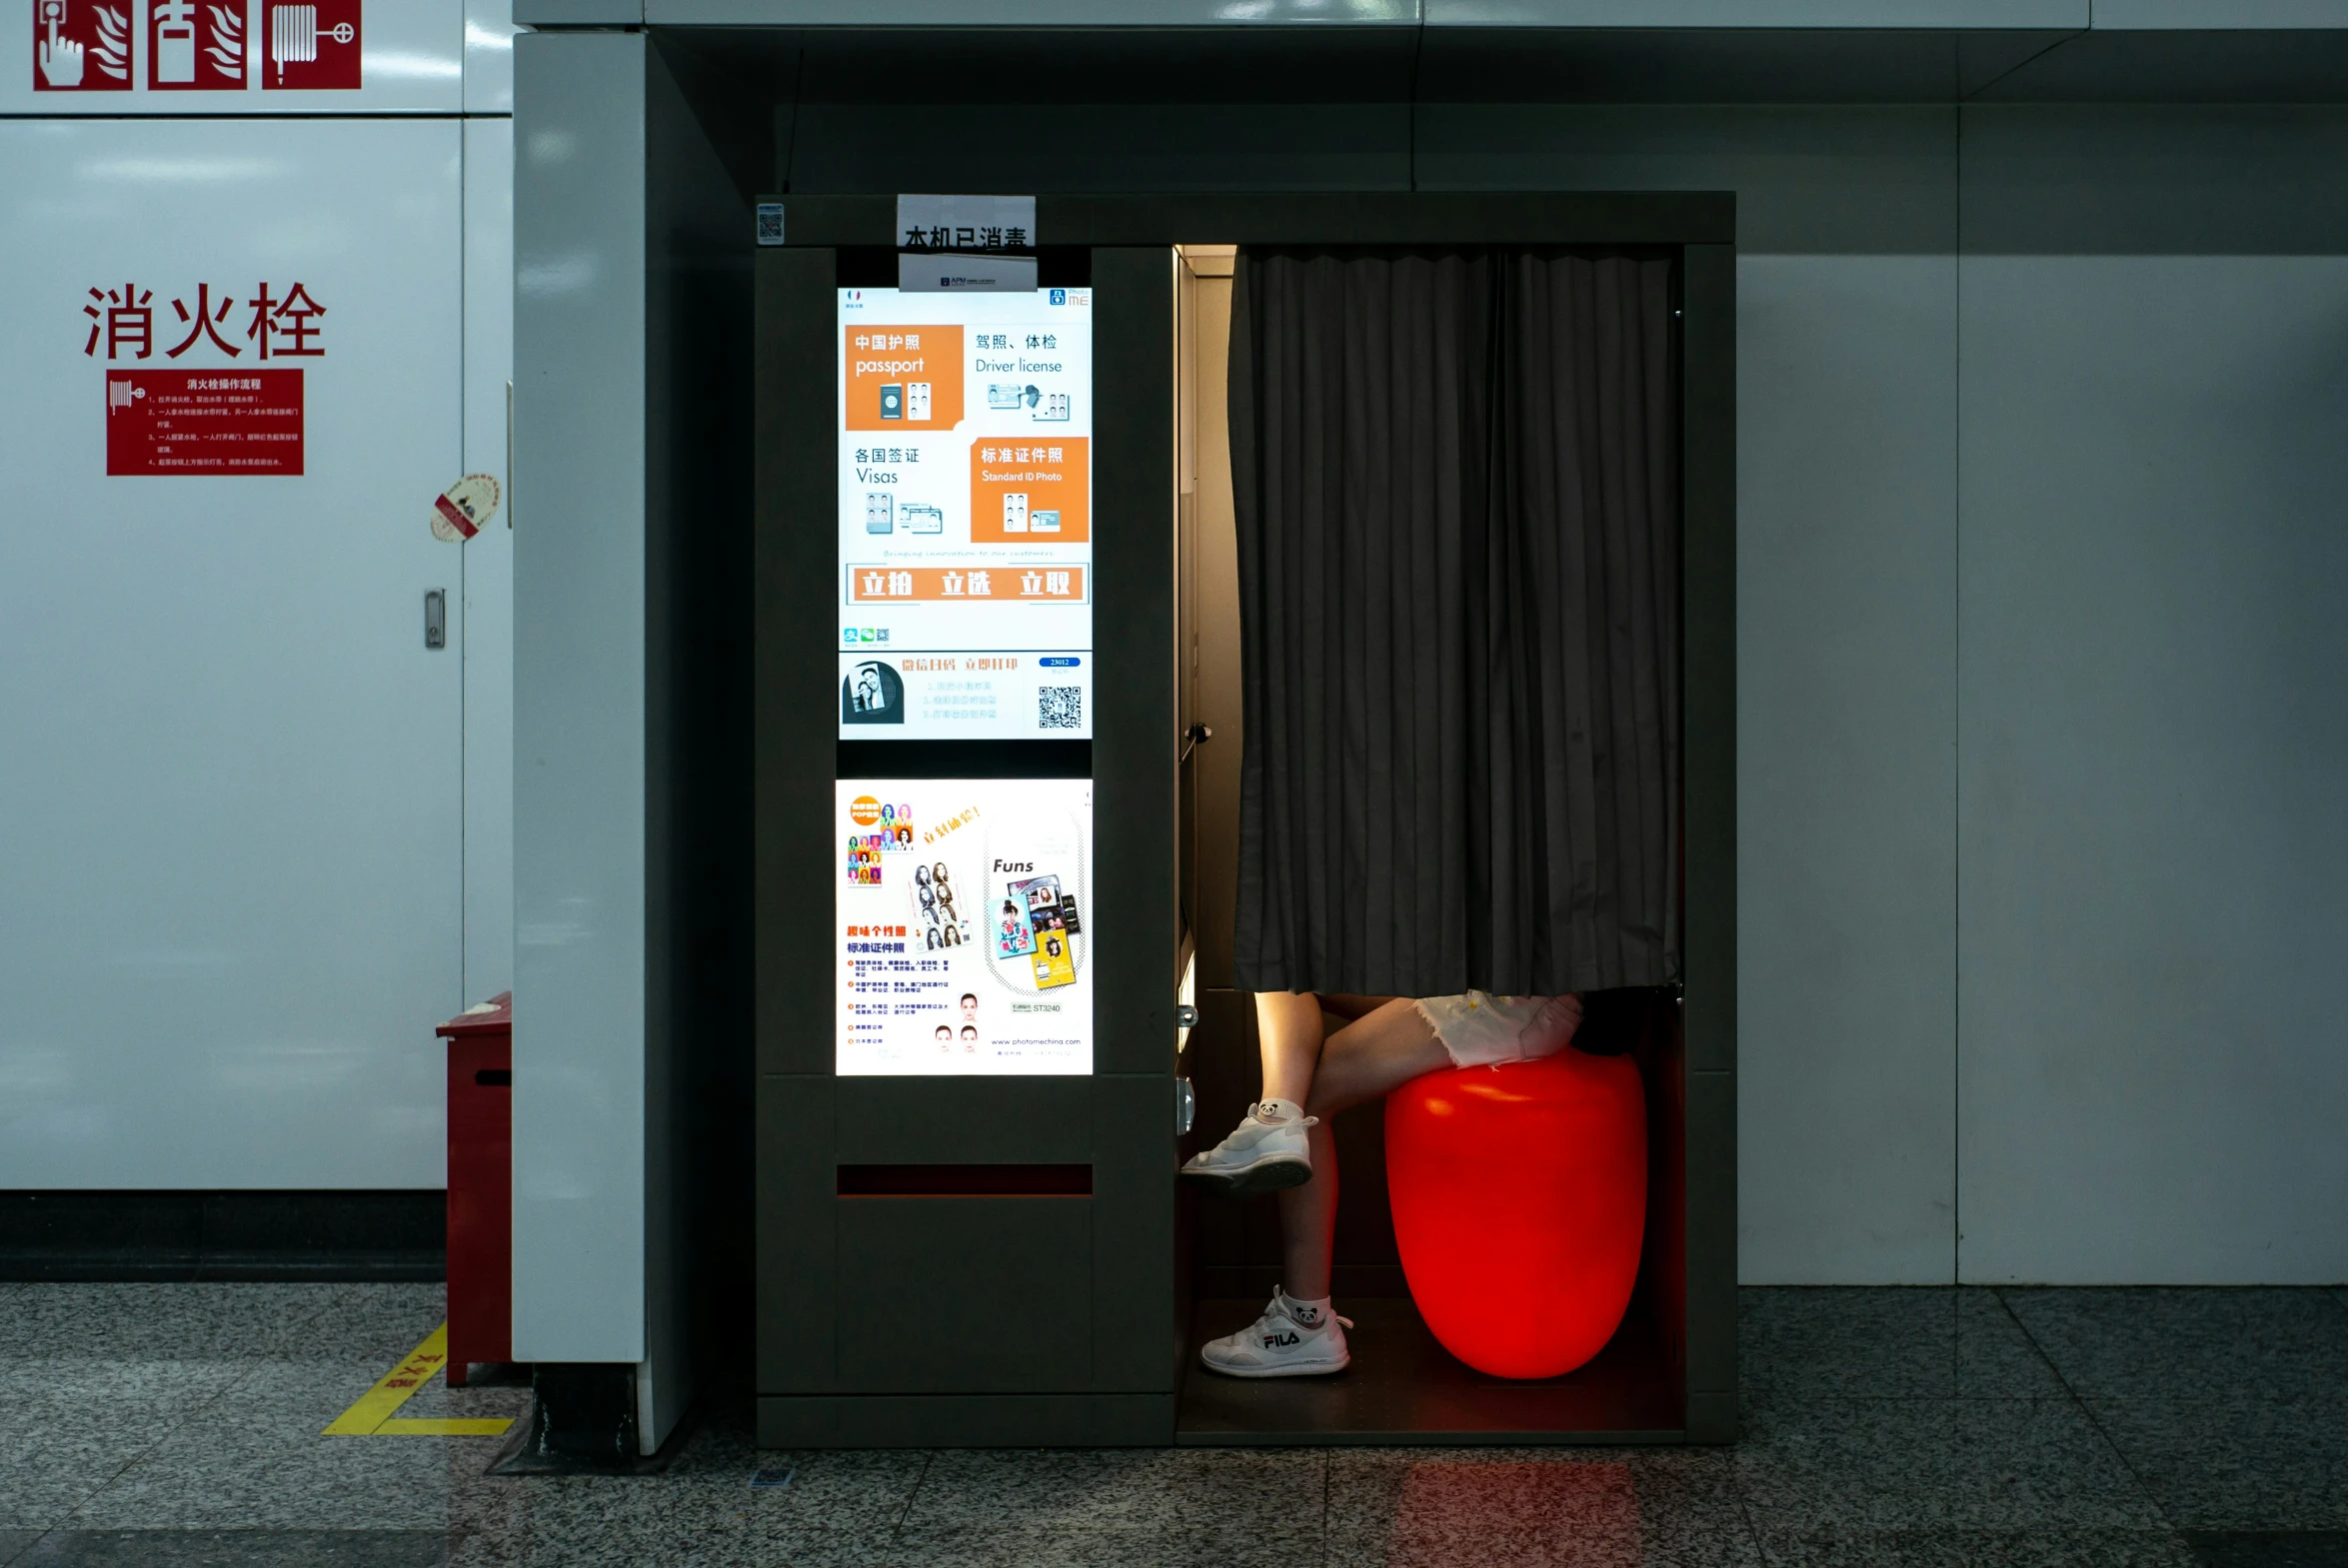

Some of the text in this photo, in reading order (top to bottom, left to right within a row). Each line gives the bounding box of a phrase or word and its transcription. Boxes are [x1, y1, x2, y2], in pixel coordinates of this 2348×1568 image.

[905, 226, 1028, 248] 本机已消毒
[83, 282, 328, 361] 消火栓
[856, 335, 921, 351] 中国护照
[976, 335, 1058, 350] 驾照、体检
[856, 358, 925, 377] passport
[976, 358, 1063, 373] Driver license
[187, 379, 261, 390] 消火栓操作流程
[855, 448, 920, 463] 各国签证
[982, 447, 1064, 464] 标准证件照
[856, 468, 899, 484] Visas
[982, 470, 1063, 482] Standard ID Photo
[862, 571, 1070, 596] 立拍 立选 立取
[902, 658, 1019, 672] 微信扫码 立即打印
[993, 858, 1034, 872] Funs
[847, 925, 907, 937] 趣味个性照
[847, 942, 906, 953] 标准证件照
[1262, 1331, 1300, 1349] FILA
